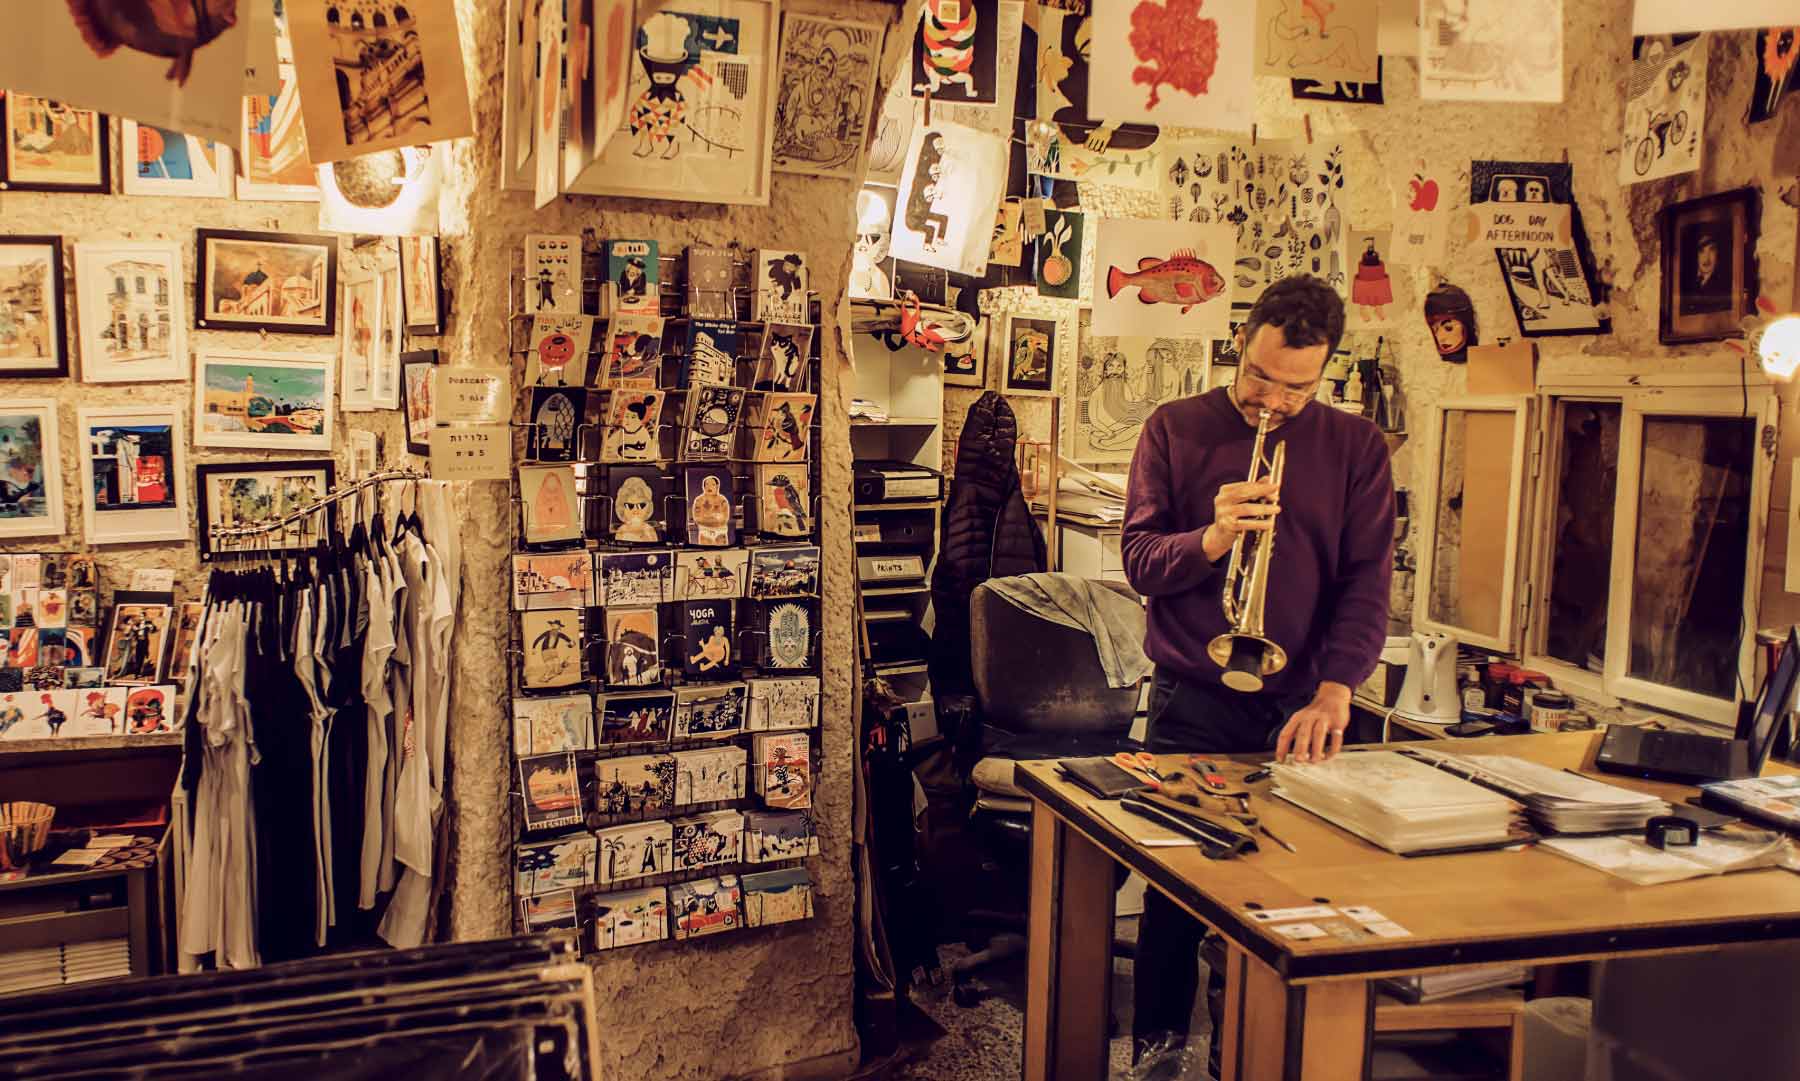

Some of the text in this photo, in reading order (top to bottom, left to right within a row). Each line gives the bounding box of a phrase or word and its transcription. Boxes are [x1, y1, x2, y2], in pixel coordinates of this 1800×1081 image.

[1494, 214, 1547, 227] DOG DAY
[1486, 229, 1553, 242] AFTERNOON
[689, 607, 715, 619] YOGA
[529, 816, 582, 830] PALESTINE
